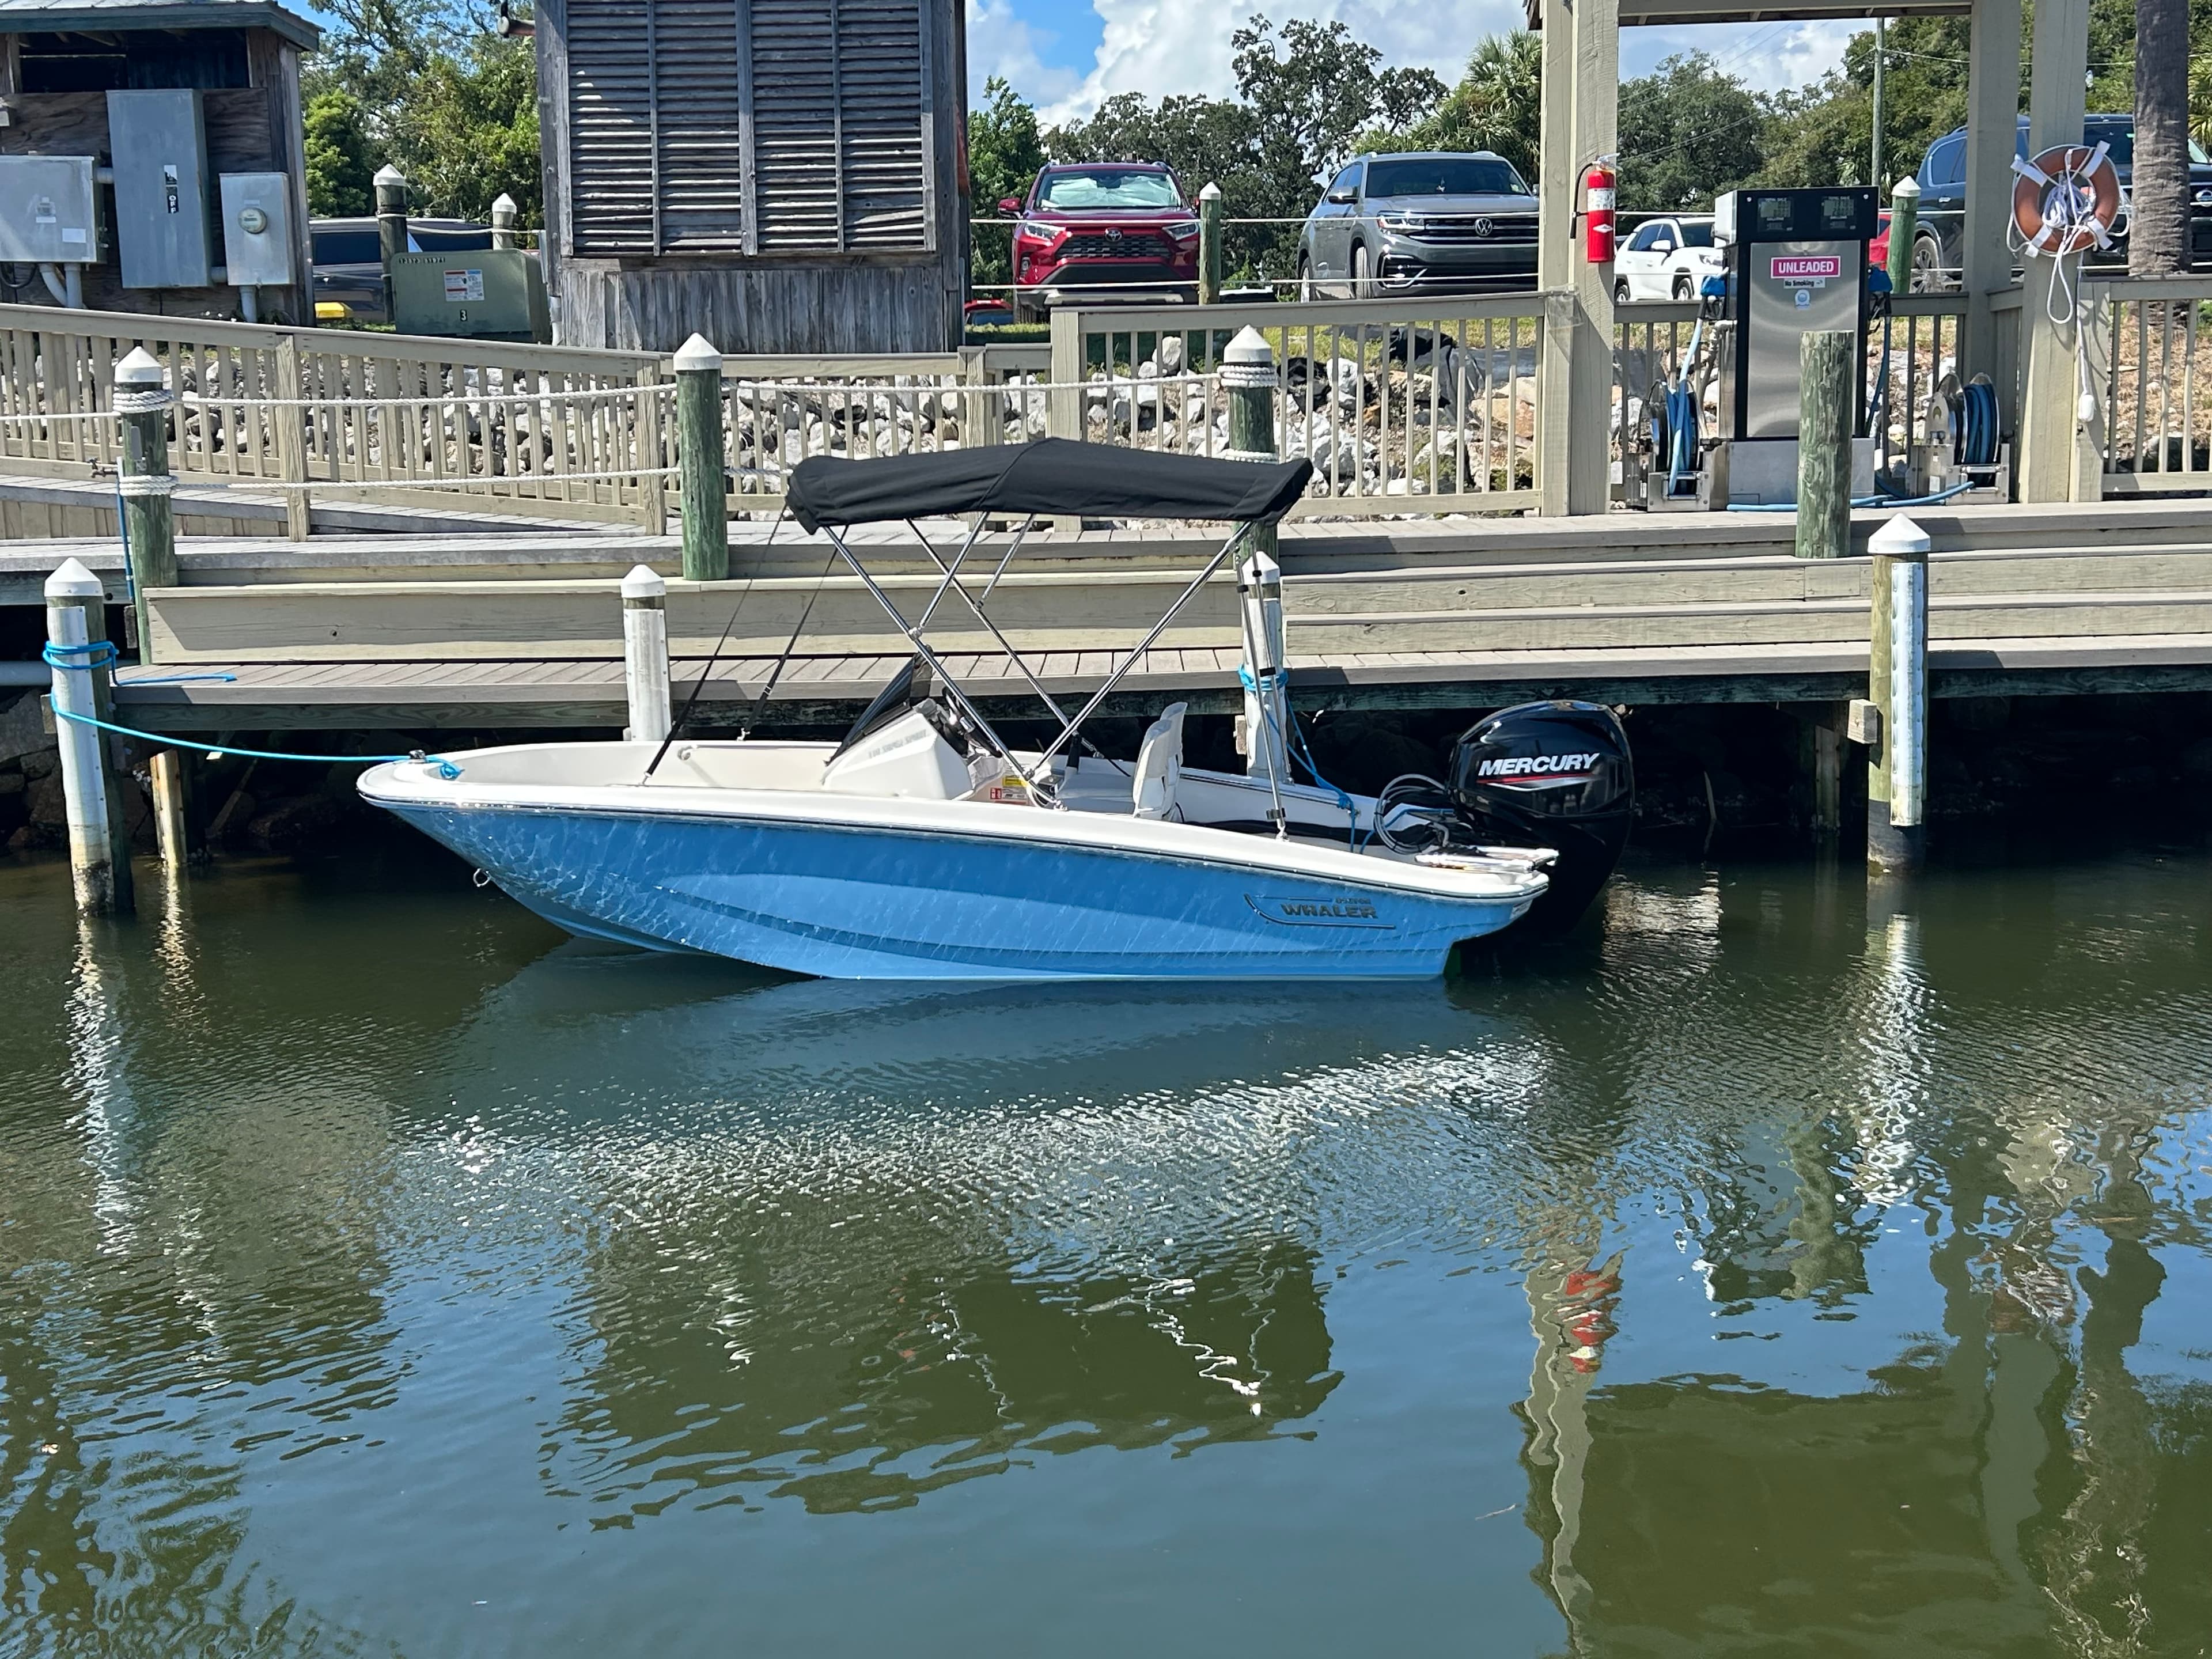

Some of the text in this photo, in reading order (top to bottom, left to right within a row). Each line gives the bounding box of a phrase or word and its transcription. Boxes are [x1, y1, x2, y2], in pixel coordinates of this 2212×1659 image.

[1778, 261, 1834, 274] UNLEADED
[461, 309, 467, 321] 3
[1478, 753, 1600, 776] MERCURY
[1281, 904, 1378, 919] WHALER
